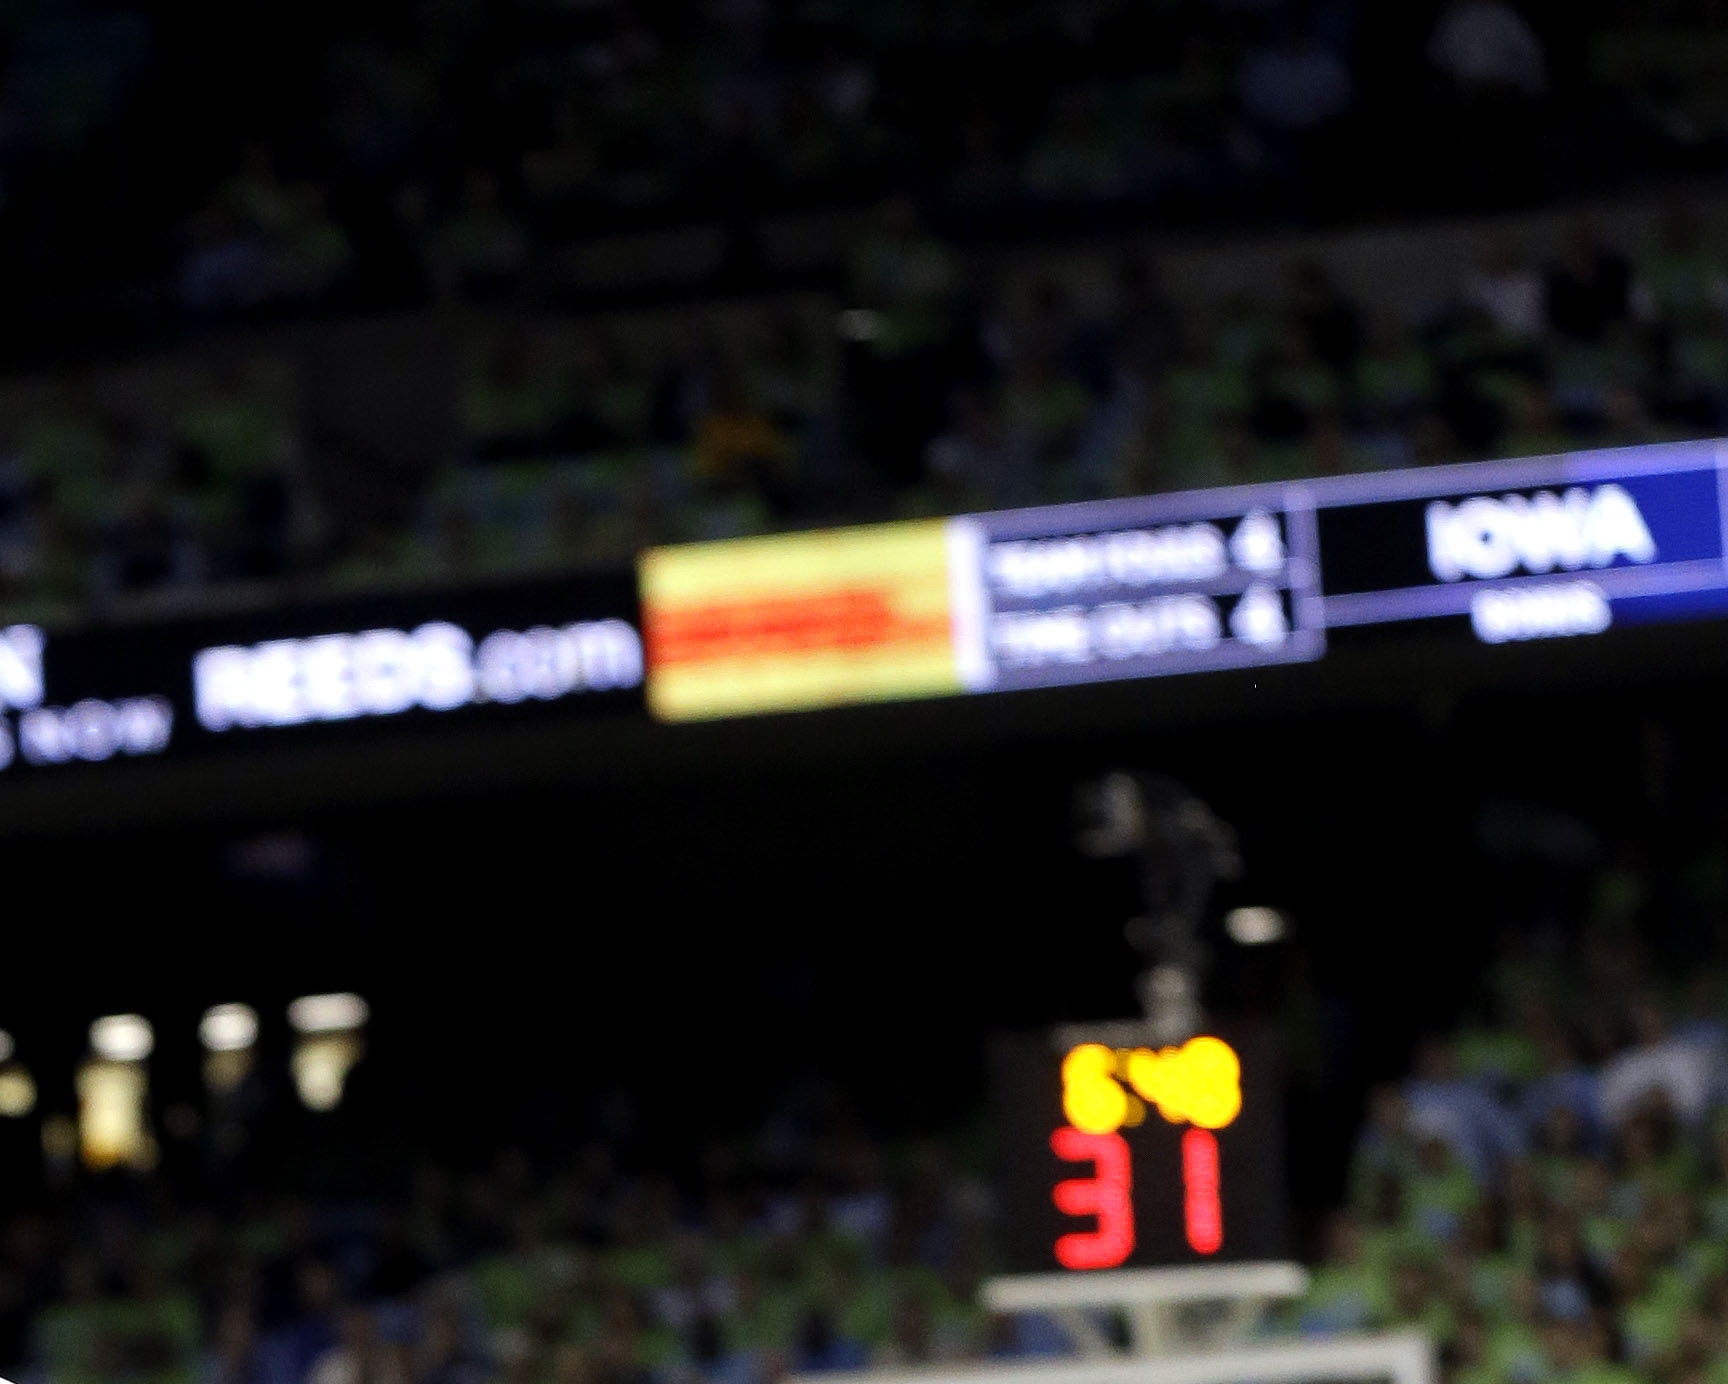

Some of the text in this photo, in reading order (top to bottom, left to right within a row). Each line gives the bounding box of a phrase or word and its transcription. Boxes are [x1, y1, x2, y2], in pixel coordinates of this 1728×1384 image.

[1229, 505, 1285, 573] 4
[1425, 483, 1658, 583] IOWA
[1229, 582, 1288, 649] 4
[193, 618, 645, 732] REEDS.com
[1049, 1125, 1223, 1271] 31
